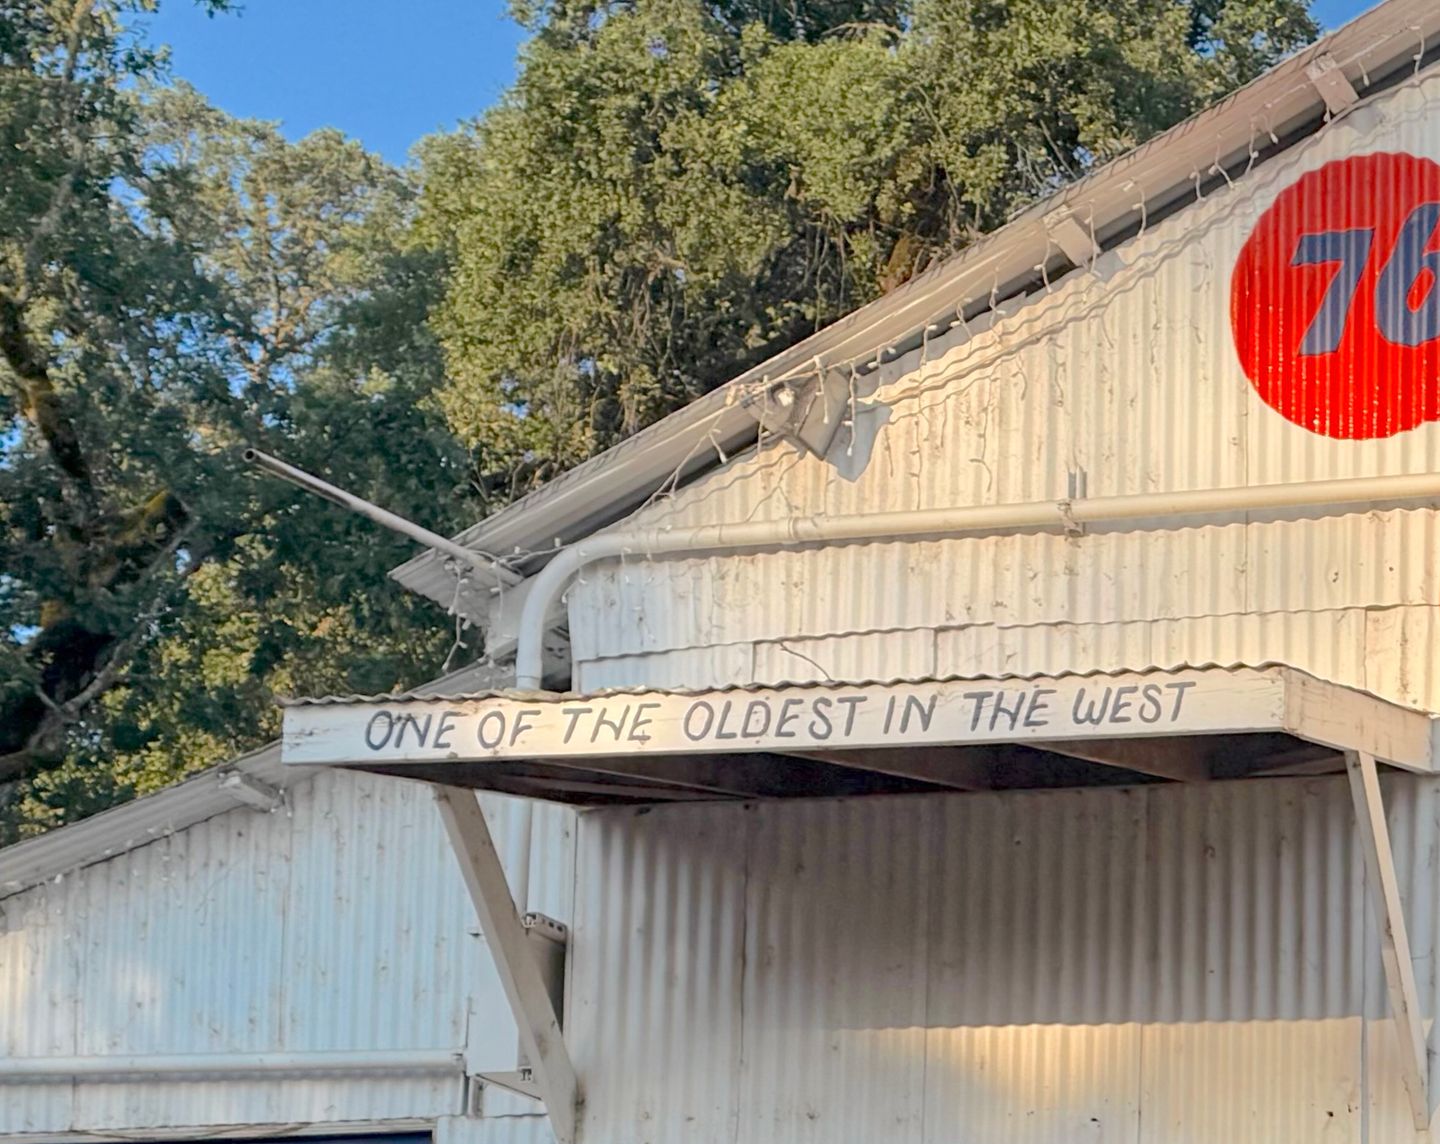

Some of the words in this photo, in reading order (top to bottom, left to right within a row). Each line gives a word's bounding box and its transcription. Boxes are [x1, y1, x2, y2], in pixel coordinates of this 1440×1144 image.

[364, 708, 459, 752] ONE
[476, 708, 541, 749] OF
[562, 702, 661, 745] THE
[683, 695, 867, 742] OLDEST
[882, 693, 940, 735] IN
[962, 688, 1057, 733] THE
[1072, 680, 1197, 729] WEST
